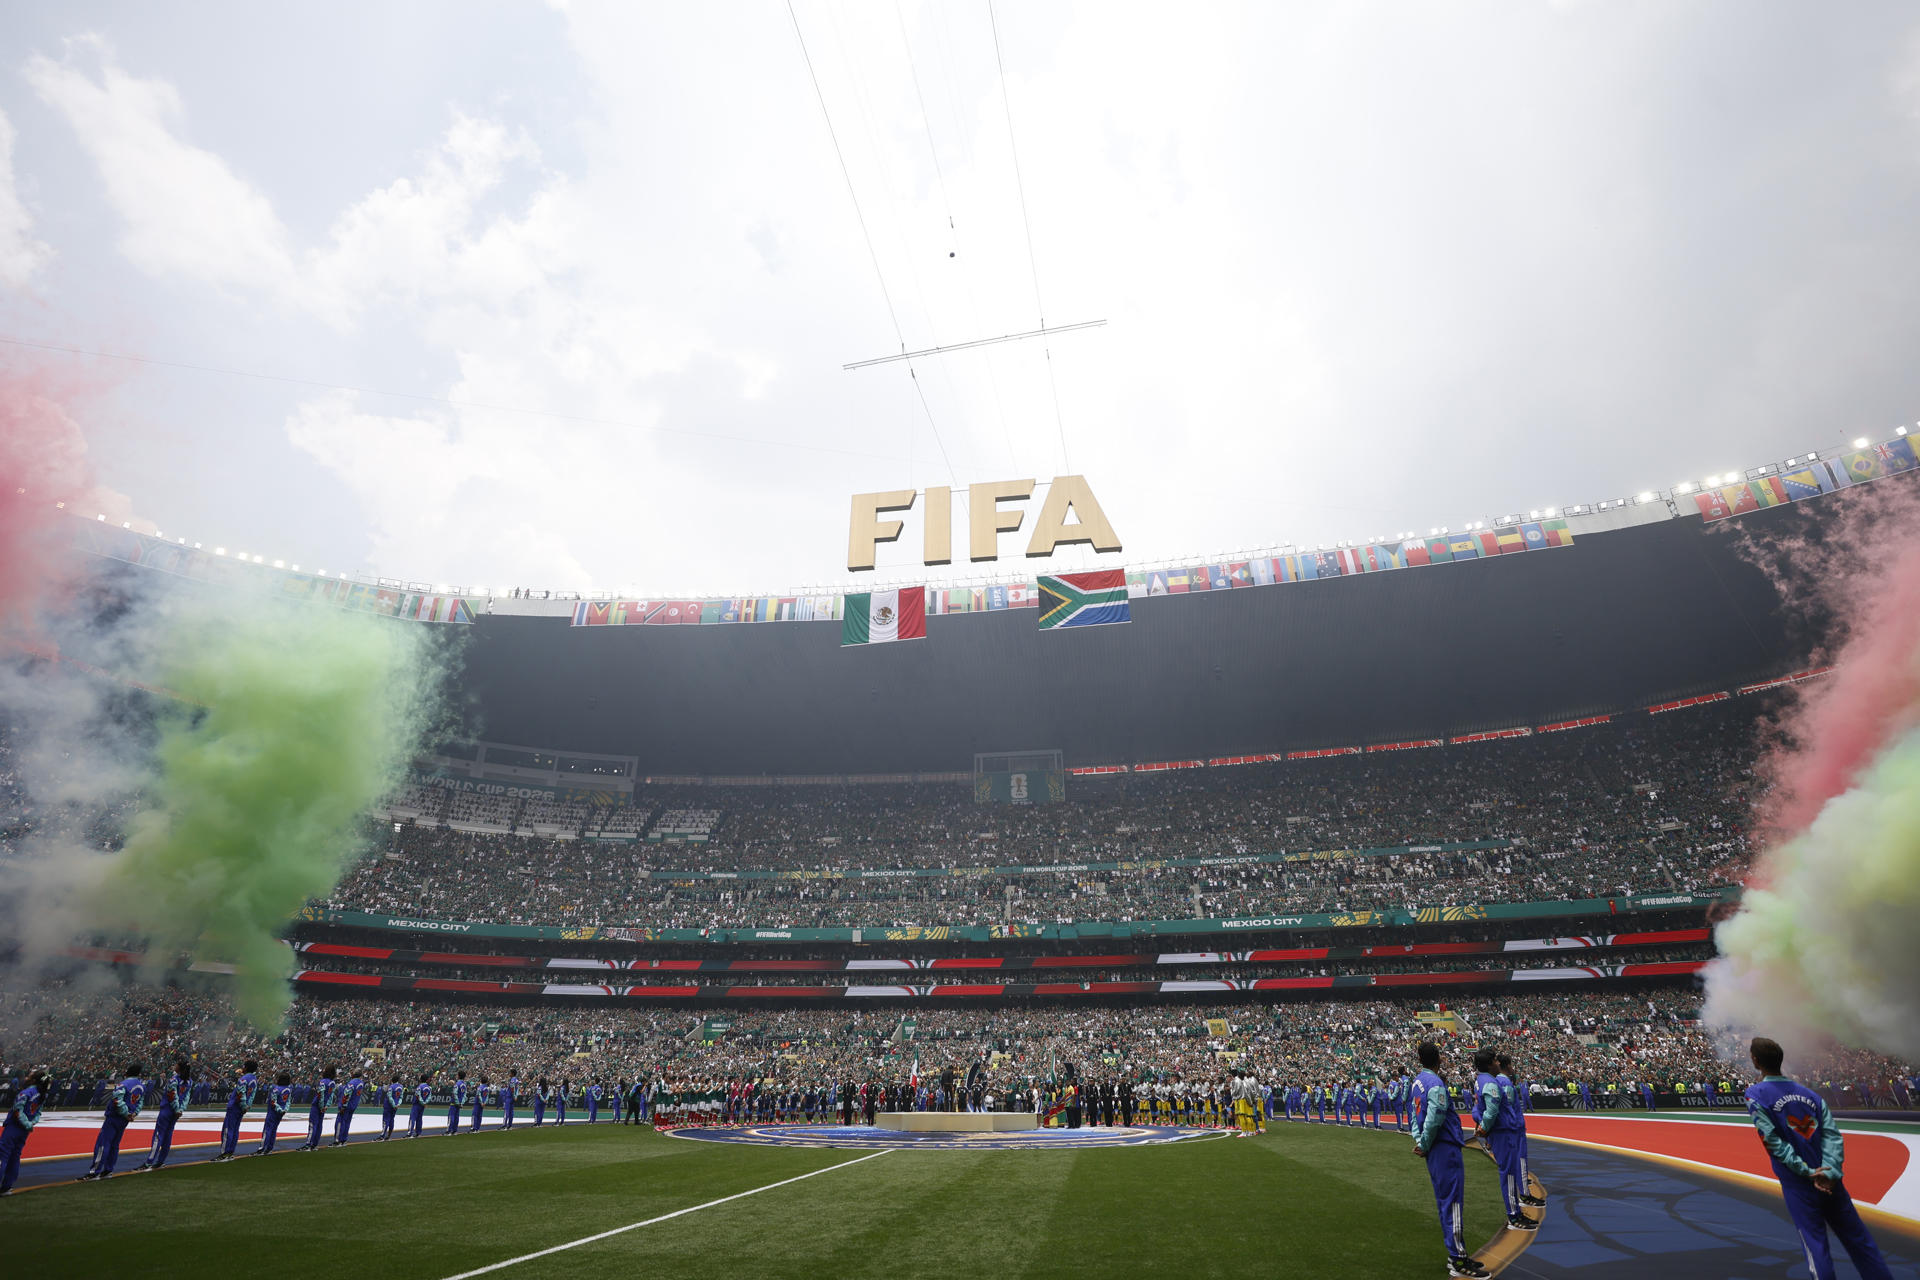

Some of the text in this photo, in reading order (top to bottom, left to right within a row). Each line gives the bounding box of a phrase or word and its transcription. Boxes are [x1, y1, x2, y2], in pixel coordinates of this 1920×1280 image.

[847, 475, 1122, 572] FIFA
[421, 775, 474, 792] WORLD
[477, 784, 504, 795] CUP
[507, 787, 555, 801] 2026
[1641, 896, 1693, 906] #FIFAWorldCup
[388, 919, 471, 932] MEXICO CITY
[1222, 918, 1303, 928] MEXICO CITY
[1680, 1096, 1703, 1106] FIFA
